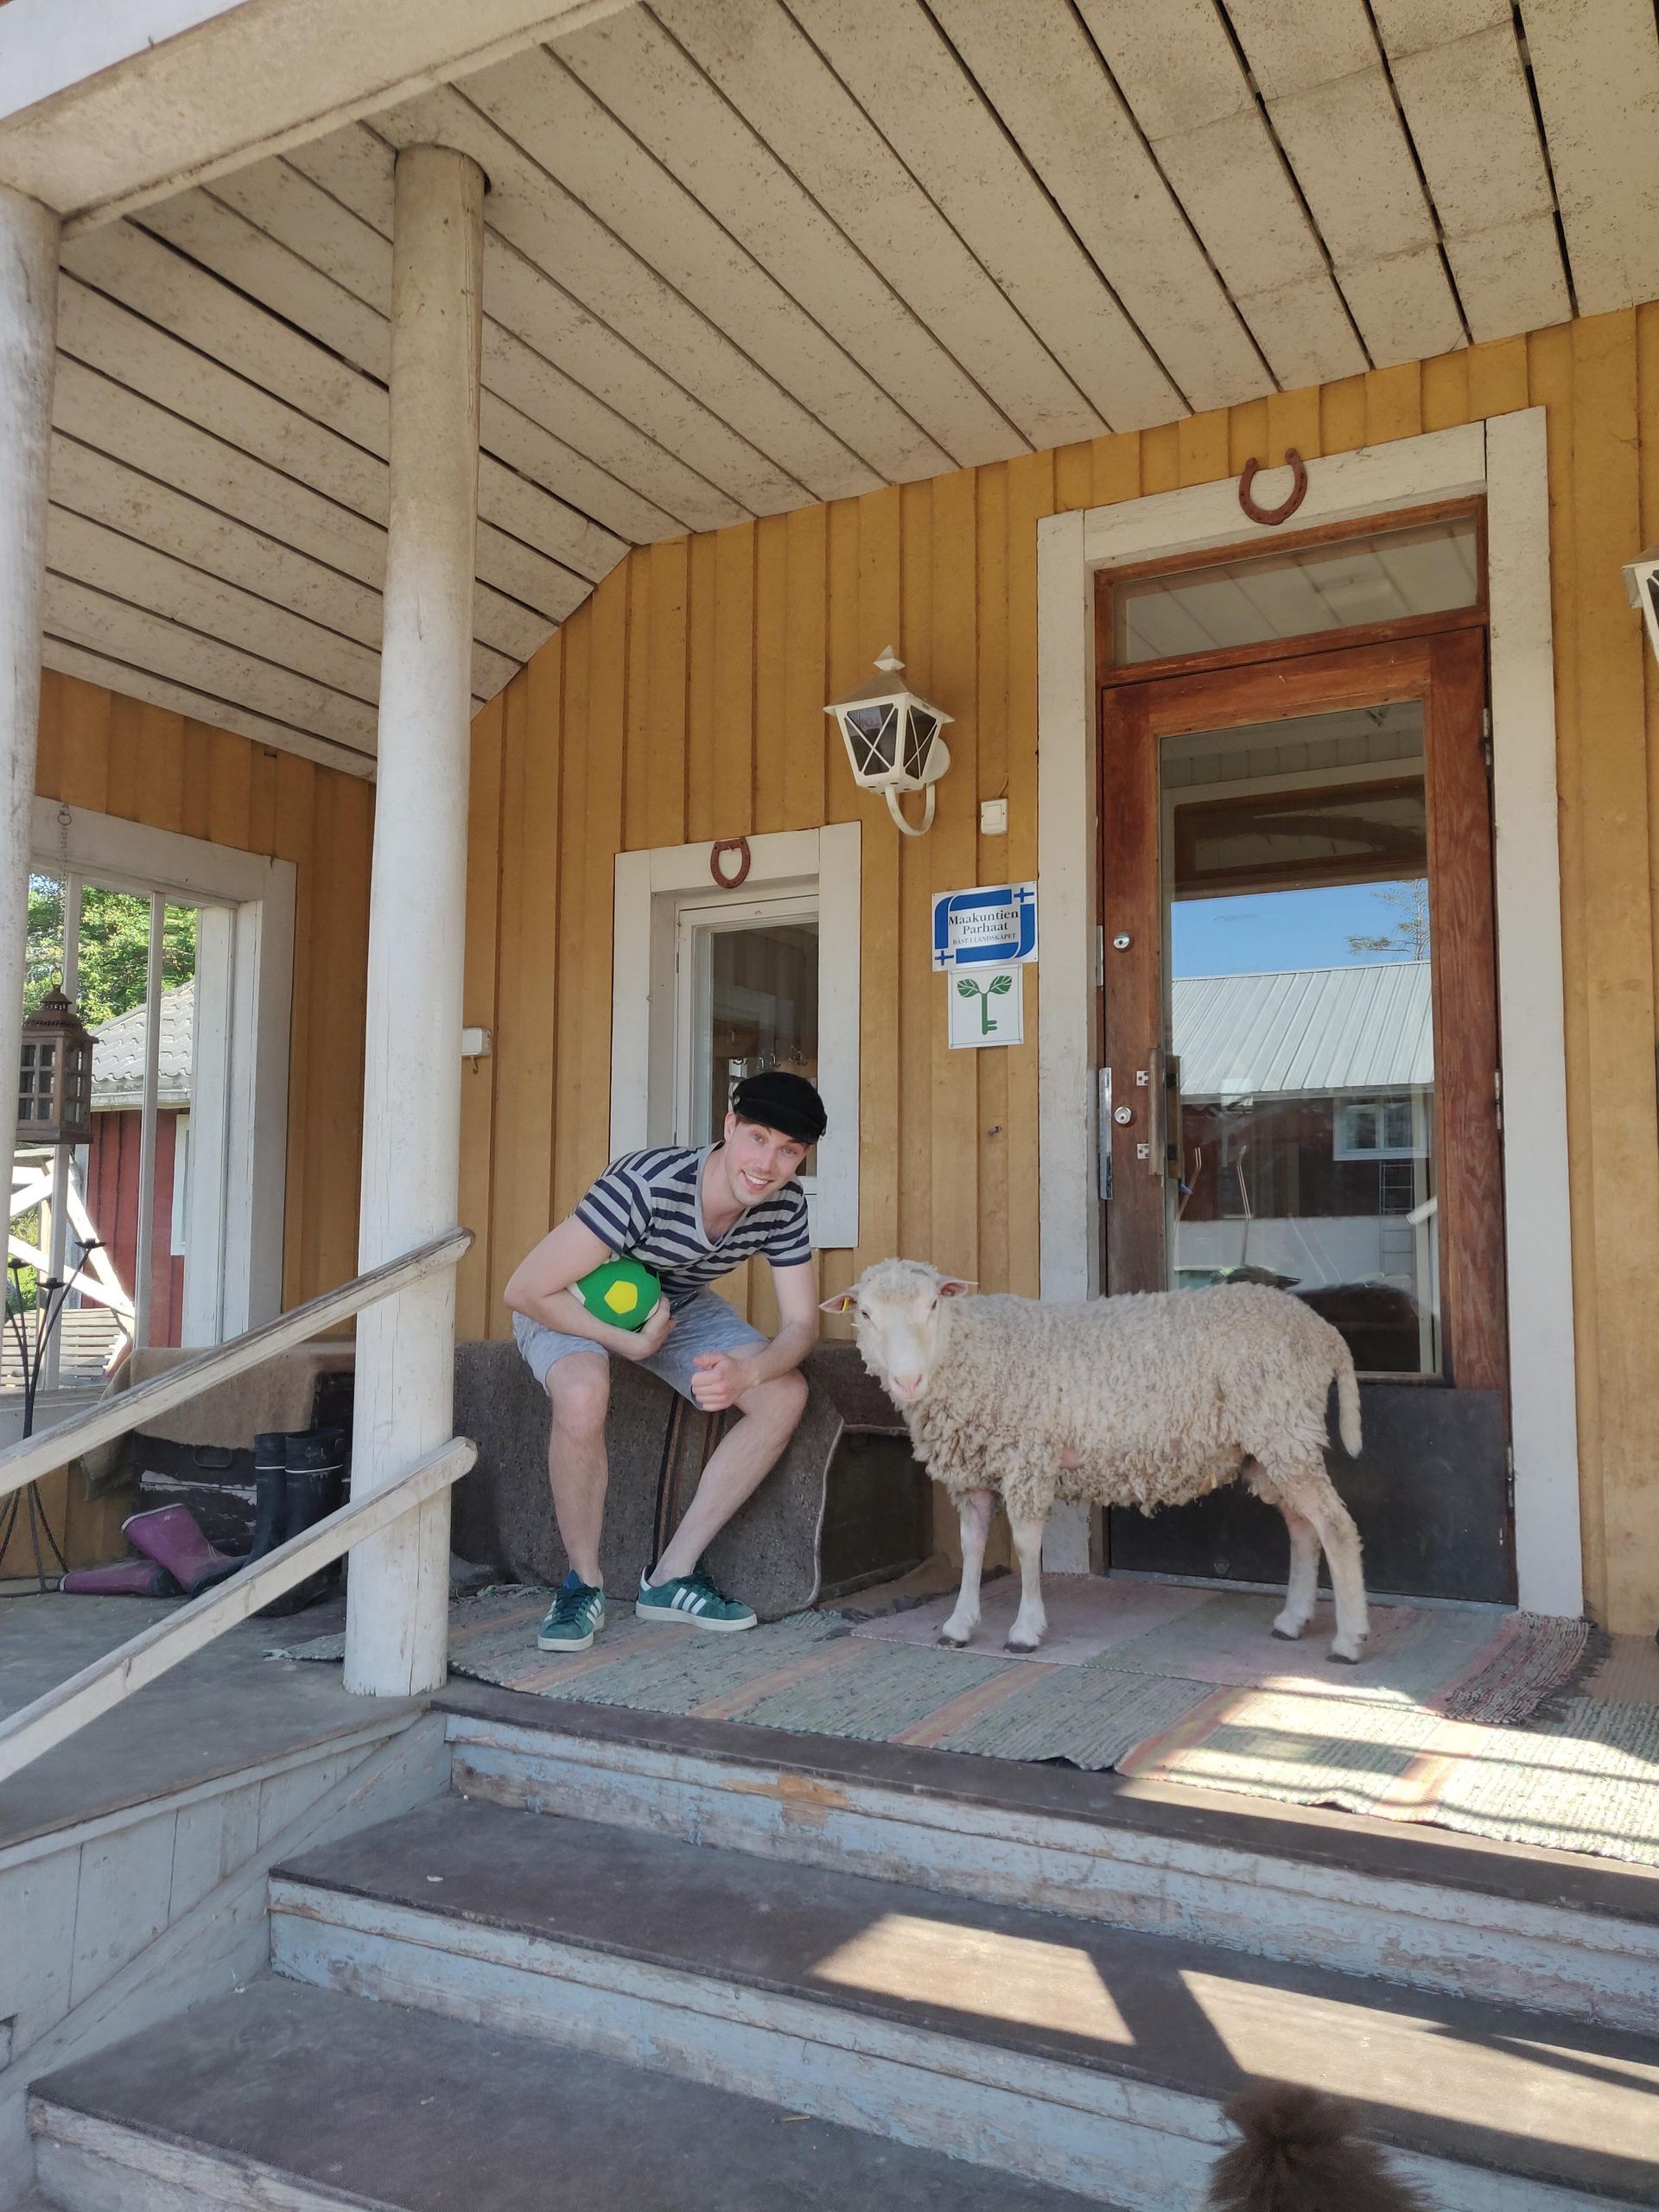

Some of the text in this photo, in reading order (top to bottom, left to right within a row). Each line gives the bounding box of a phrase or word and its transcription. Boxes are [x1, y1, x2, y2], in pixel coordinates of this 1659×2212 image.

[949, 910, 1019, 925] Maakuntien
[963, 922, 1008, 934] Parhaat
[974, 933, 1016, 943] LANDSKAPET
